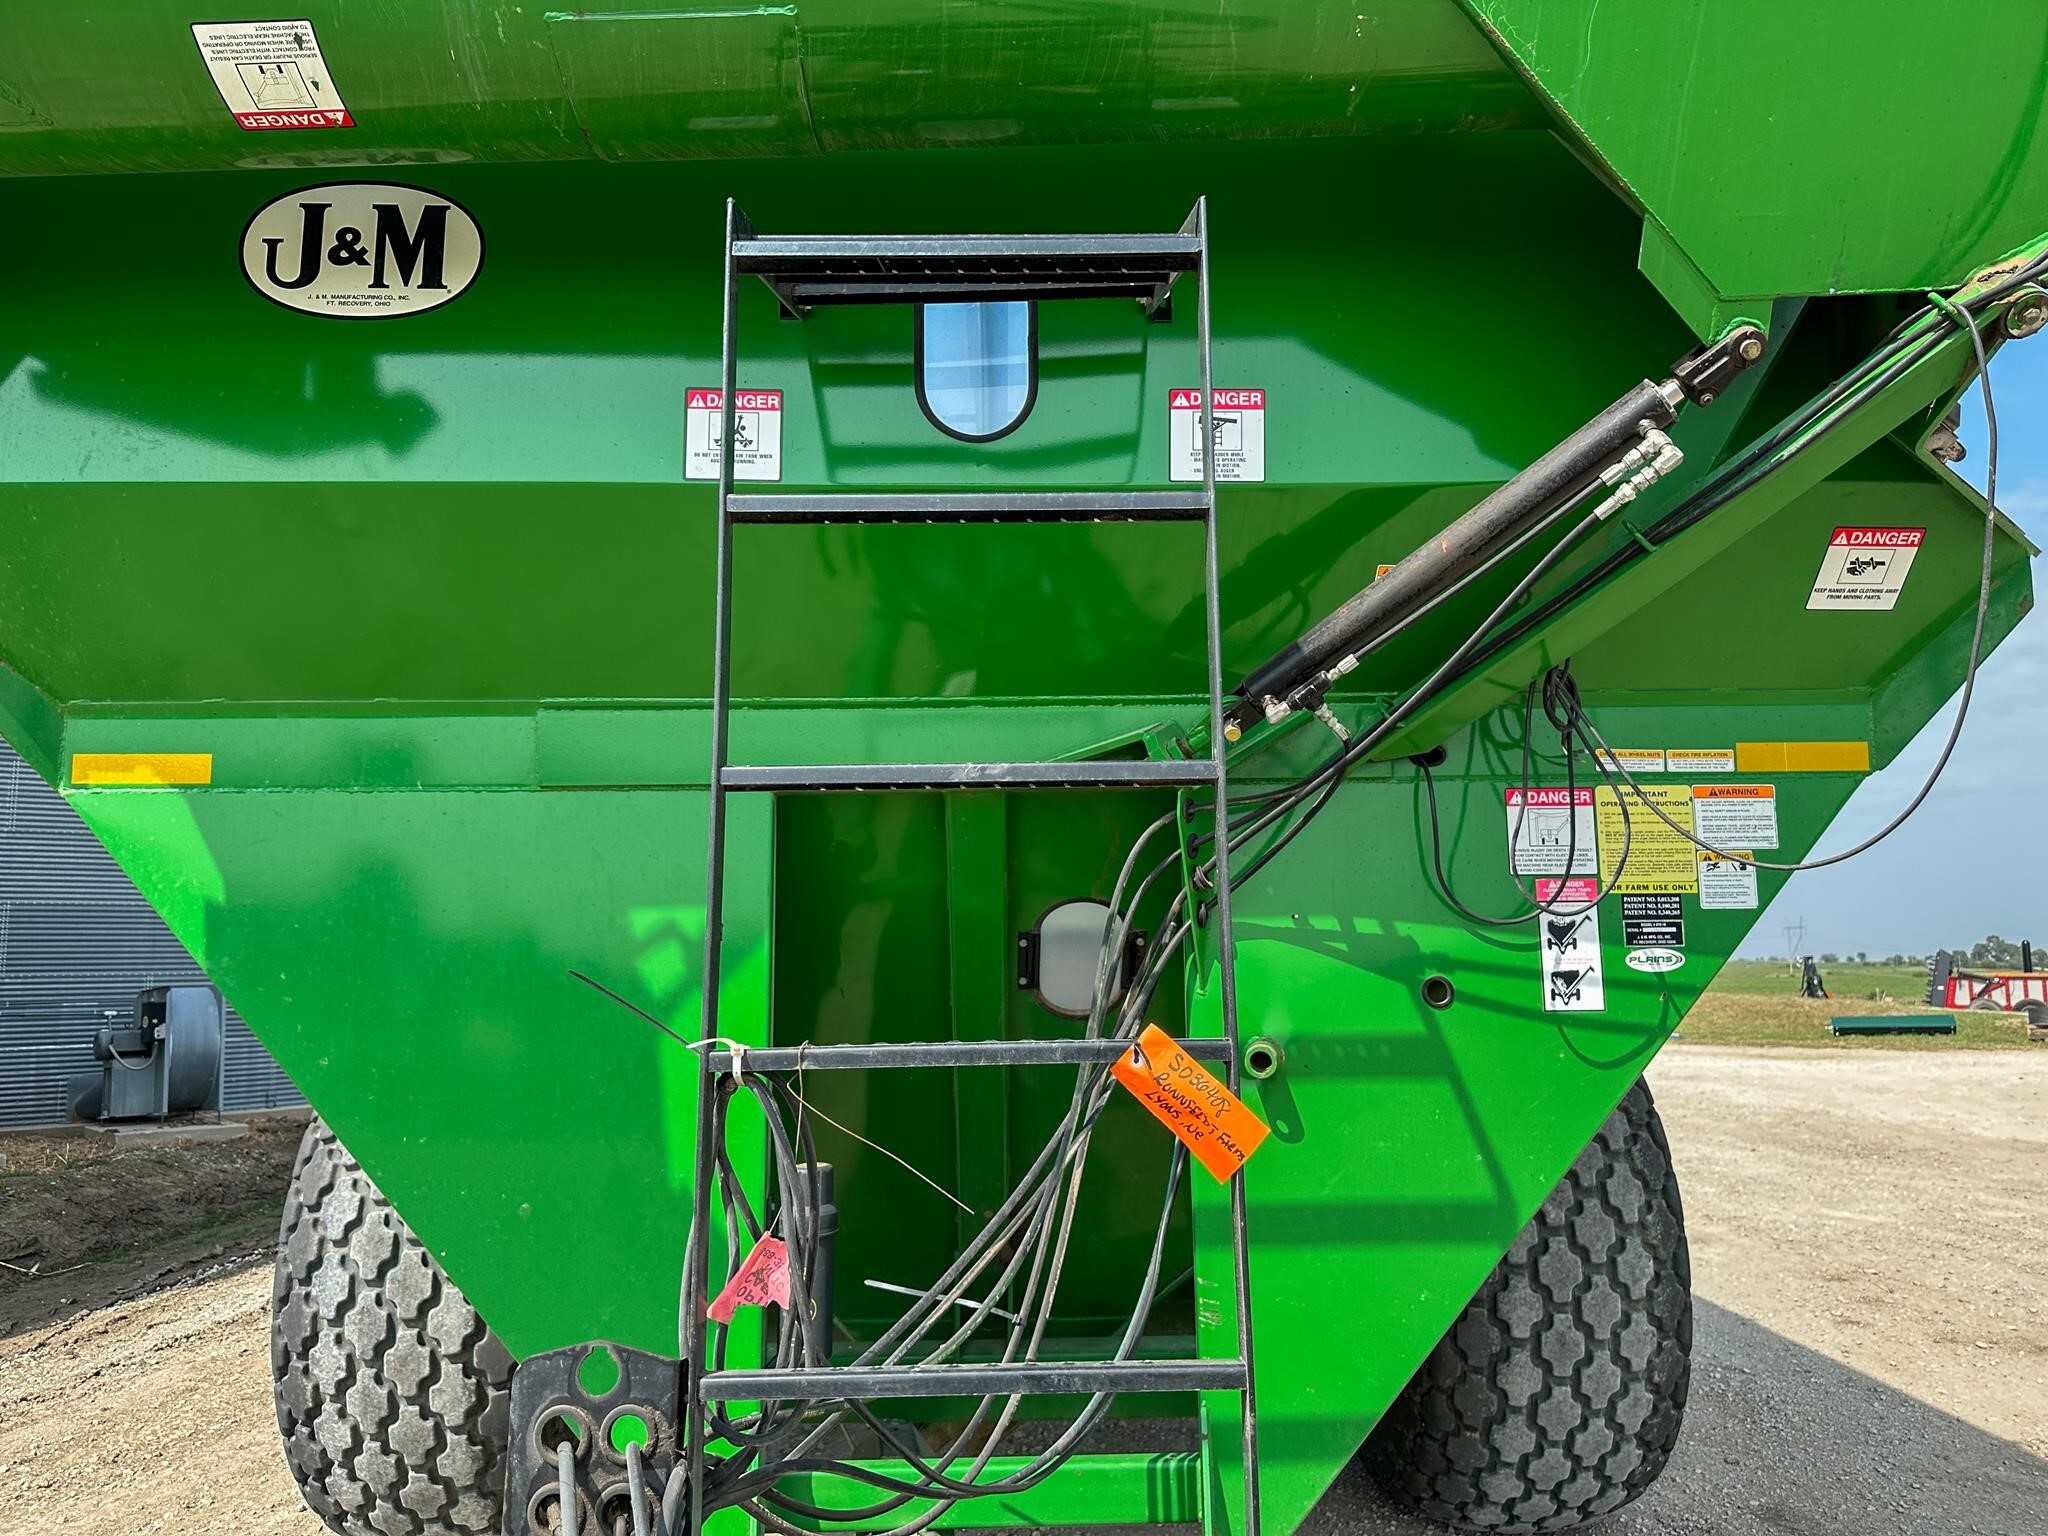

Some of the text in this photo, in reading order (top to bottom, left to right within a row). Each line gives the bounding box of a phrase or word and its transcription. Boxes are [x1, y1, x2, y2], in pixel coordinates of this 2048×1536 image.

[240, 114, 326, 127] DANGER
[1190, 392, 1262, 406] DNGER
[1849, 532, 1921, 544] DANGER
[1718, 788, 1759, 796] WARNING
